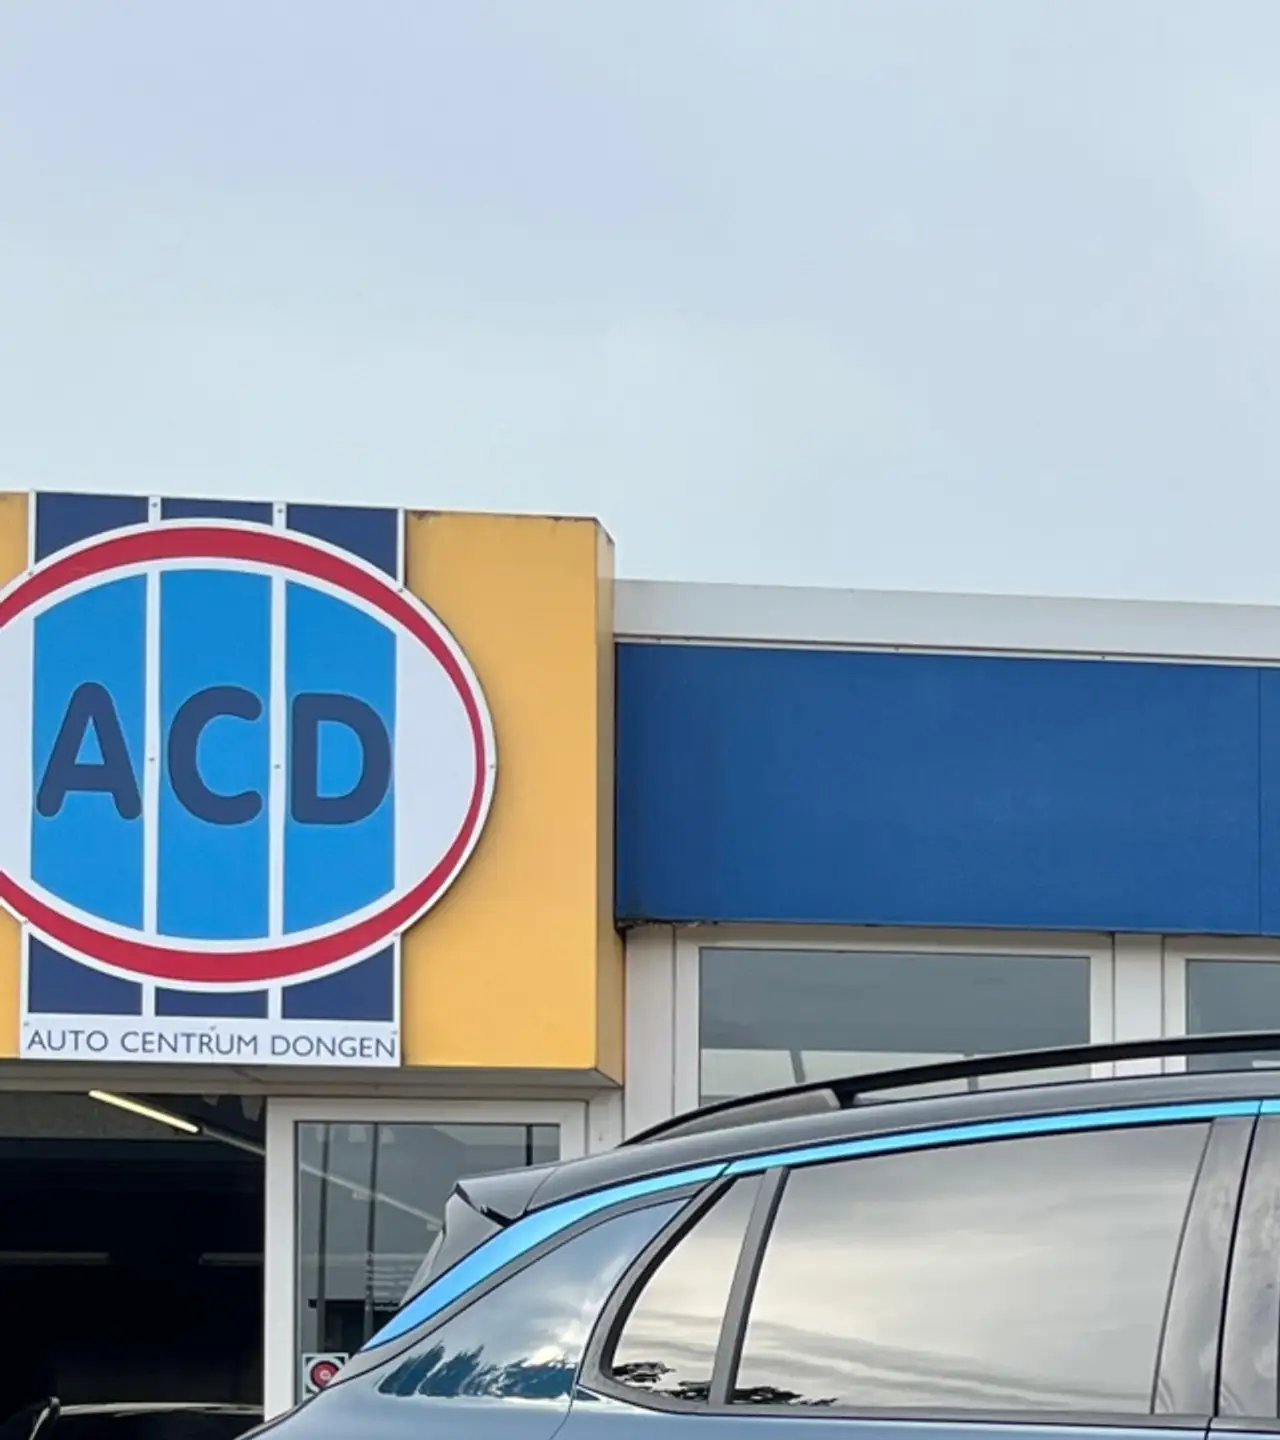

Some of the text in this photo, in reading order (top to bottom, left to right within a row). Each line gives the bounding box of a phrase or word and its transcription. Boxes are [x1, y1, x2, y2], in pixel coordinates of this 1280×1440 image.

[36, 682, 392, 826] ACD
[27, 1029, 396, 1059] AUTO CENTRUM DONGEN
